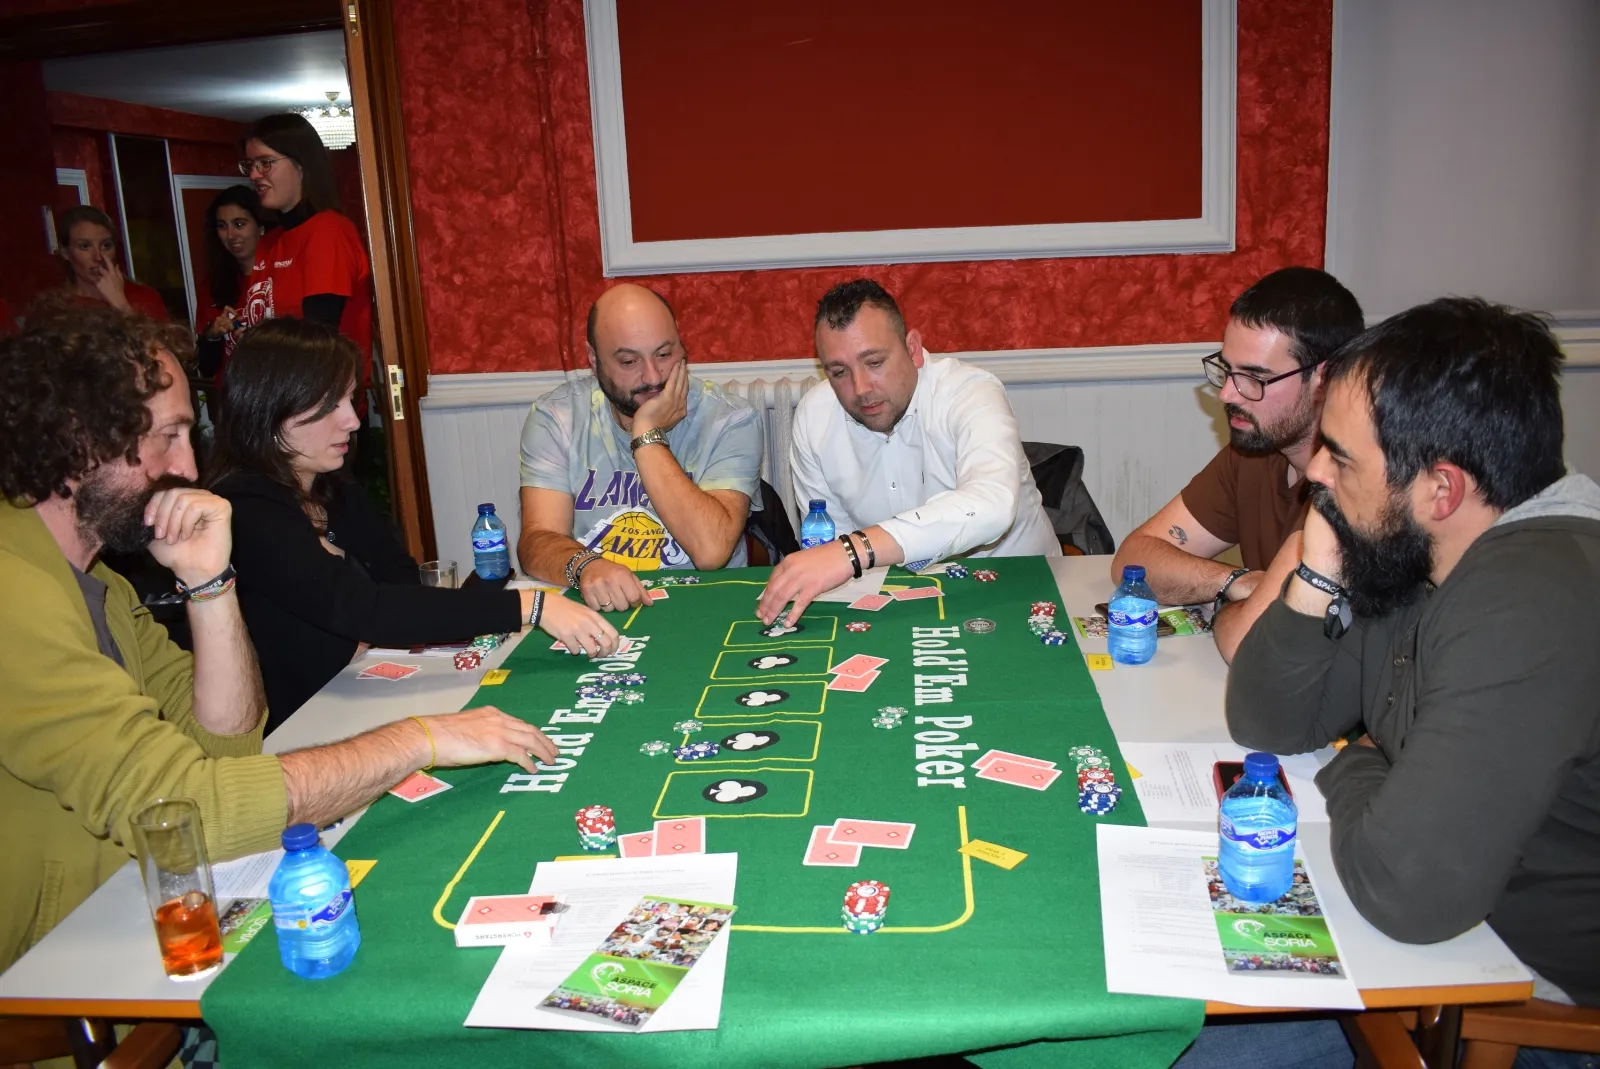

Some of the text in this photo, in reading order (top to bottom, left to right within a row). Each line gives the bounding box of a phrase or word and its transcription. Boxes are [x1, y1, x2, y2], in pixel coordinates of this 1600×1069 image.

[621, 526, 669, 535] LOS ANG
[584, 522, 685, 566] LAKERS
[911, 626, 980, 789] Hold'Em Poker
[1263, 931, 1313, 939] ASPACE
[1264, 937, 1317, 948] SORIA
[610, 976, 658, 989] ASPACE
[604, 981, 652, 998] SORIA
